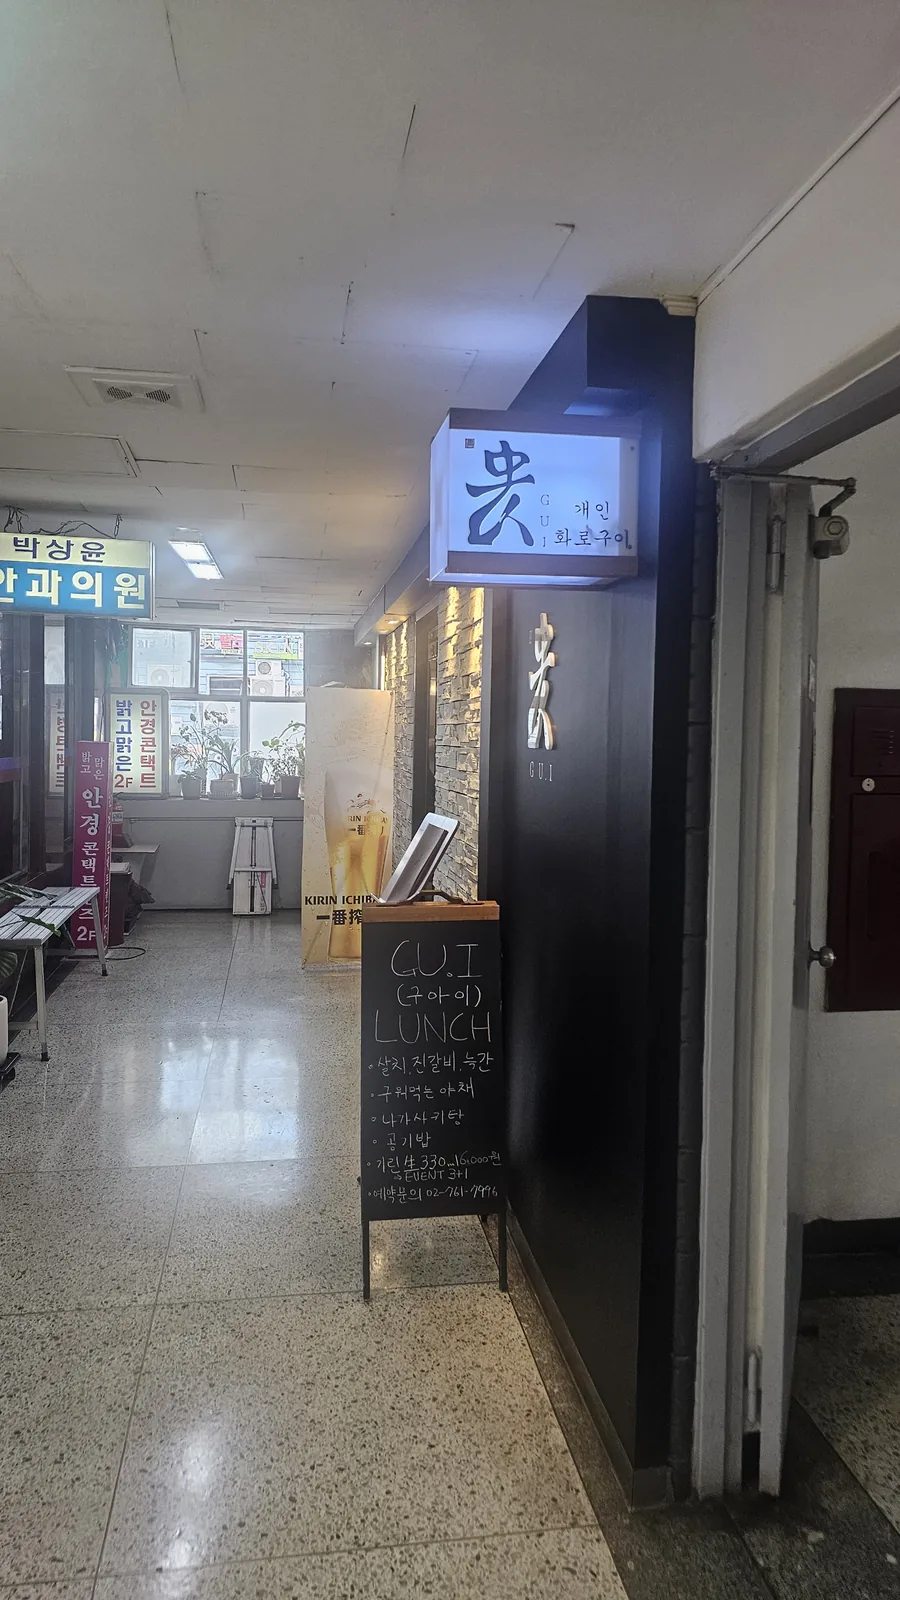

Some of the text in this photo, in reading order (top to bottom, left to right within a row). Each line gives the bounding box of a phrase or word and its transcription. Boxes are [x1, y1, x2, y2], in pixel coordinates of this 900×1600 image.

[575, 500, 609, 520] 개인
[13, 536, 106, 563] 박상윤
[554, 528, 629, 549] 화로구이
[114, 700, 133, 788] 밝고맑은 2F
[140, 700, 157, 788] 안경콘택트
[76, 786, 103, 941] 안경 콘택트즈 2F
[304, 896, 338, 905] KIRIN
[396, 983, 482, 1008] (구아이)
[374, 1010, 492, 1044] LUNCH
[439, 1076, 475, 1098] 야채
[386, 1131, 432, 1151] 공기밥
[404, 1170, 445, 1182] EVENT
[373, 1184, 498, 1204] 예약문의 02-761-7996
